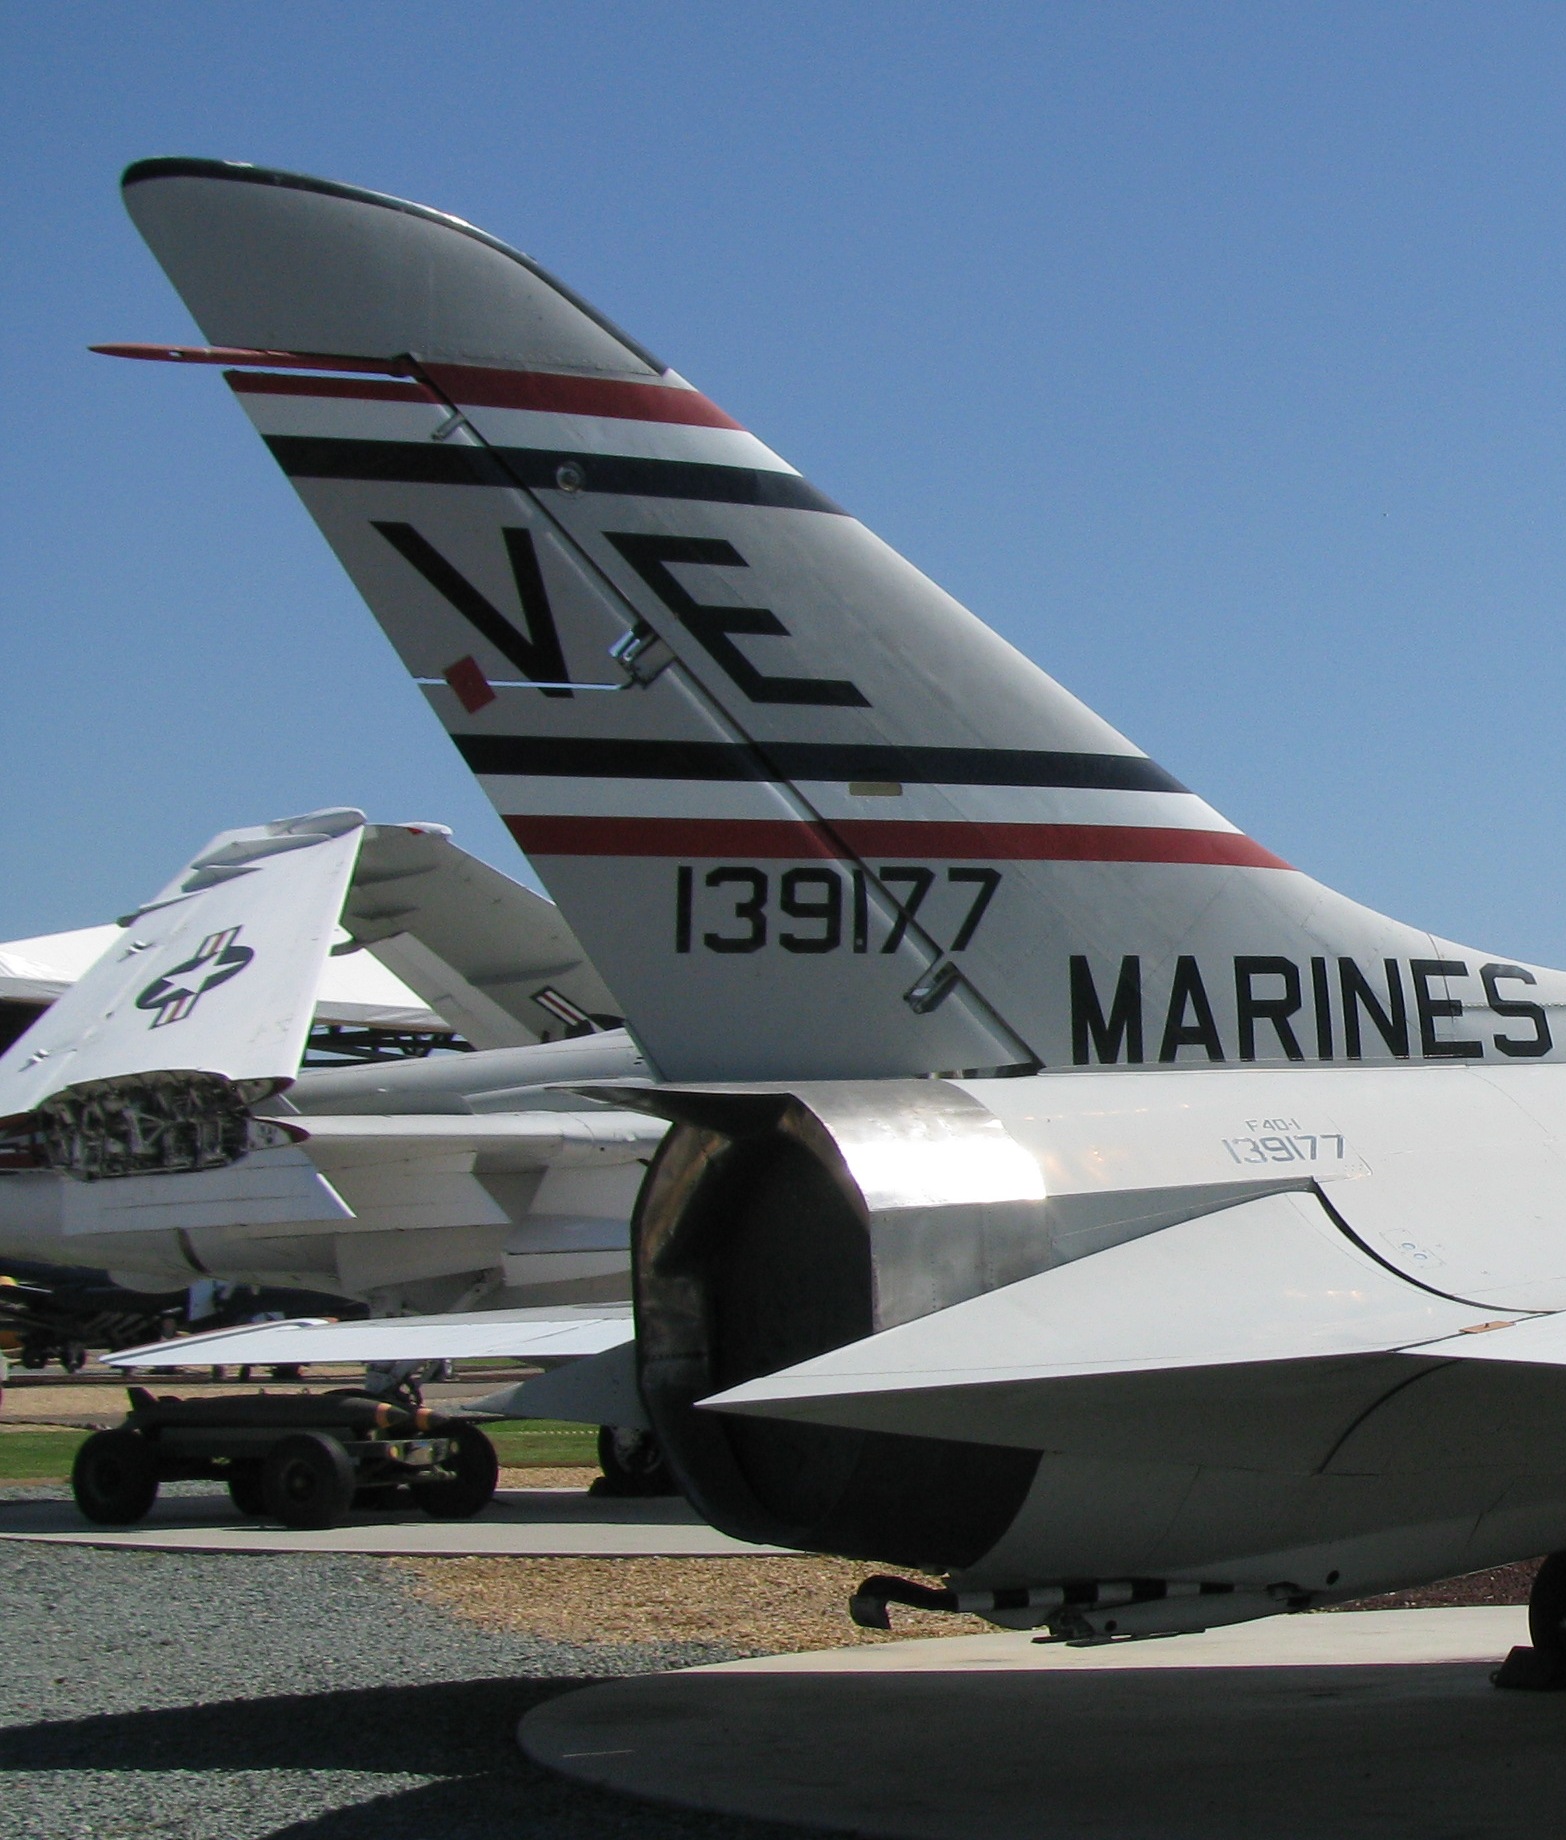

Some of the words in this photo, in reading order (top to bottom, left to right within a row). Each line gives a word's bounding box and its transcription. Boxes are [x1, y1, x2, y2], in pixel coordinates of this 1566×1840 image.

[676, 866, 1002, 953] 139177
[1069, 955, 1553, 1065] MARINES
[1221, 1133, 1344, 1164] 139177
